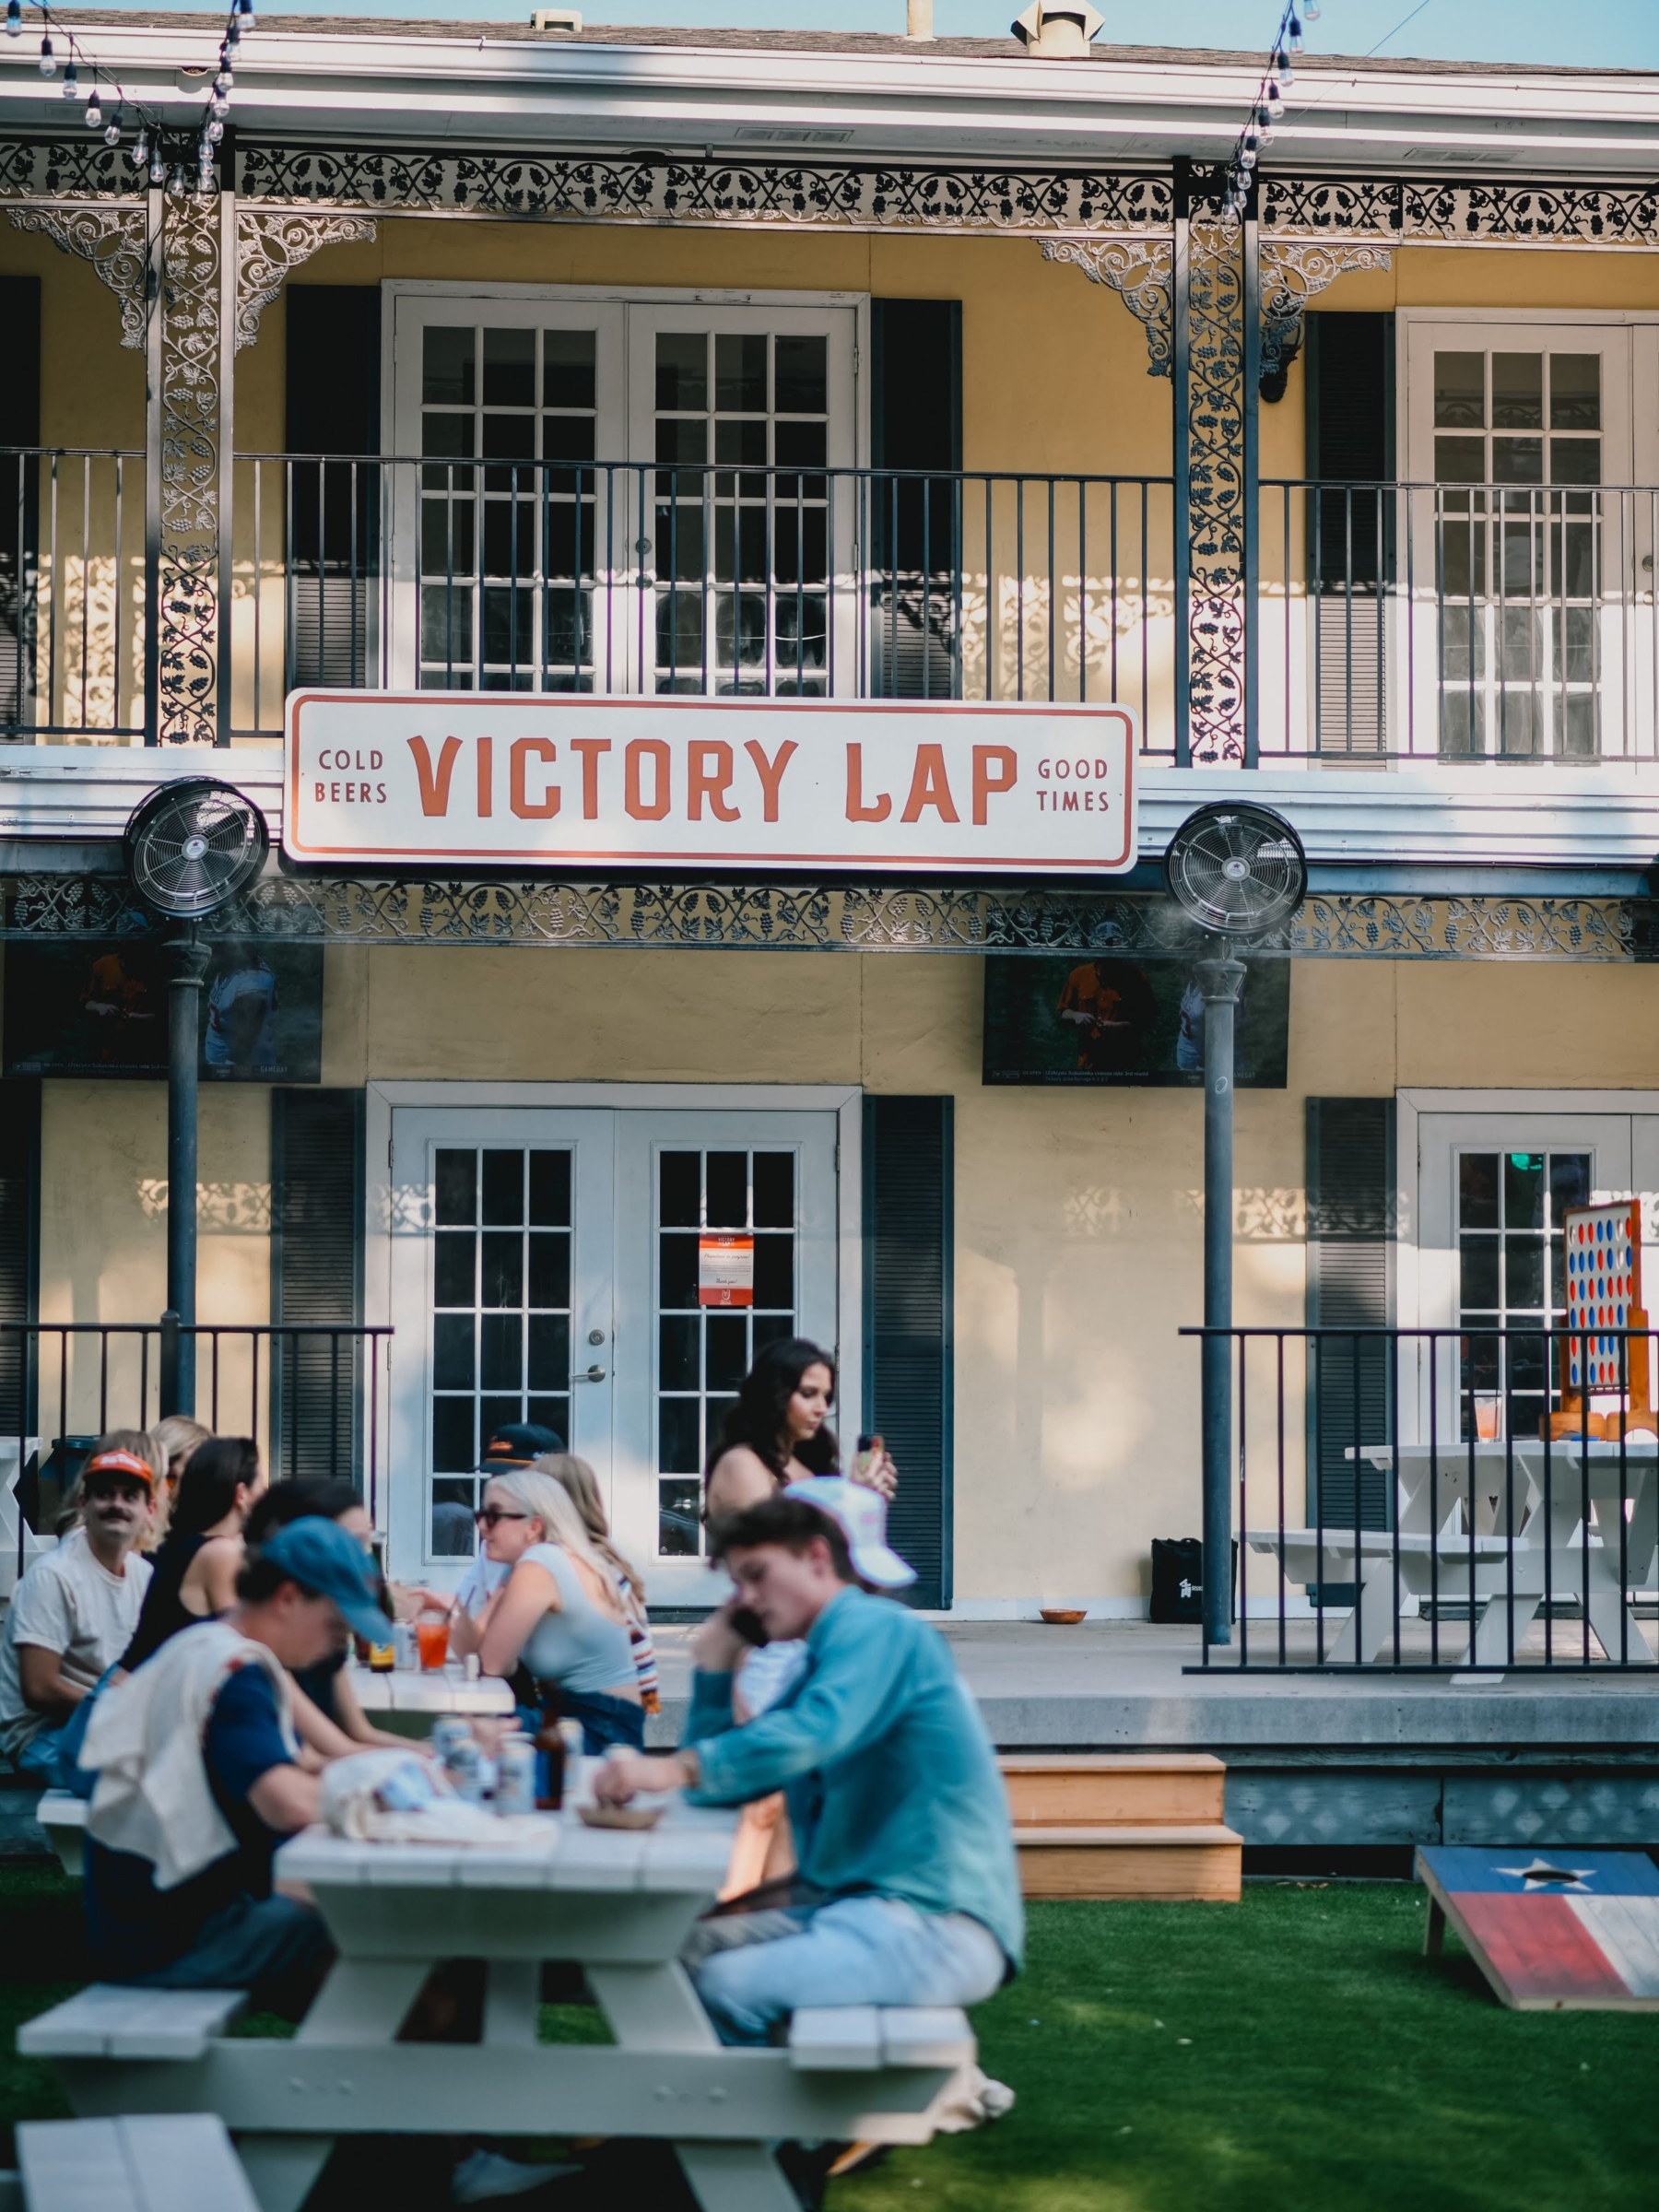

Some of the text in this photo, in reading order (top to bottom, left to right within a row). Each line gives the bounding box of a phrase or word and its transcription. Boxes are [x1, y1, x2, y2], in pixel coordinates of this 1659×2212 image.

[319, 749, 382, 770] COLD
[1038, 759, 1108, 780] GOOD
[407, 735, 1018, 825] VICTORY LAP
[314, 782, 386, 804] BEERS
[1037, 790, 1110, 812] TIMES
